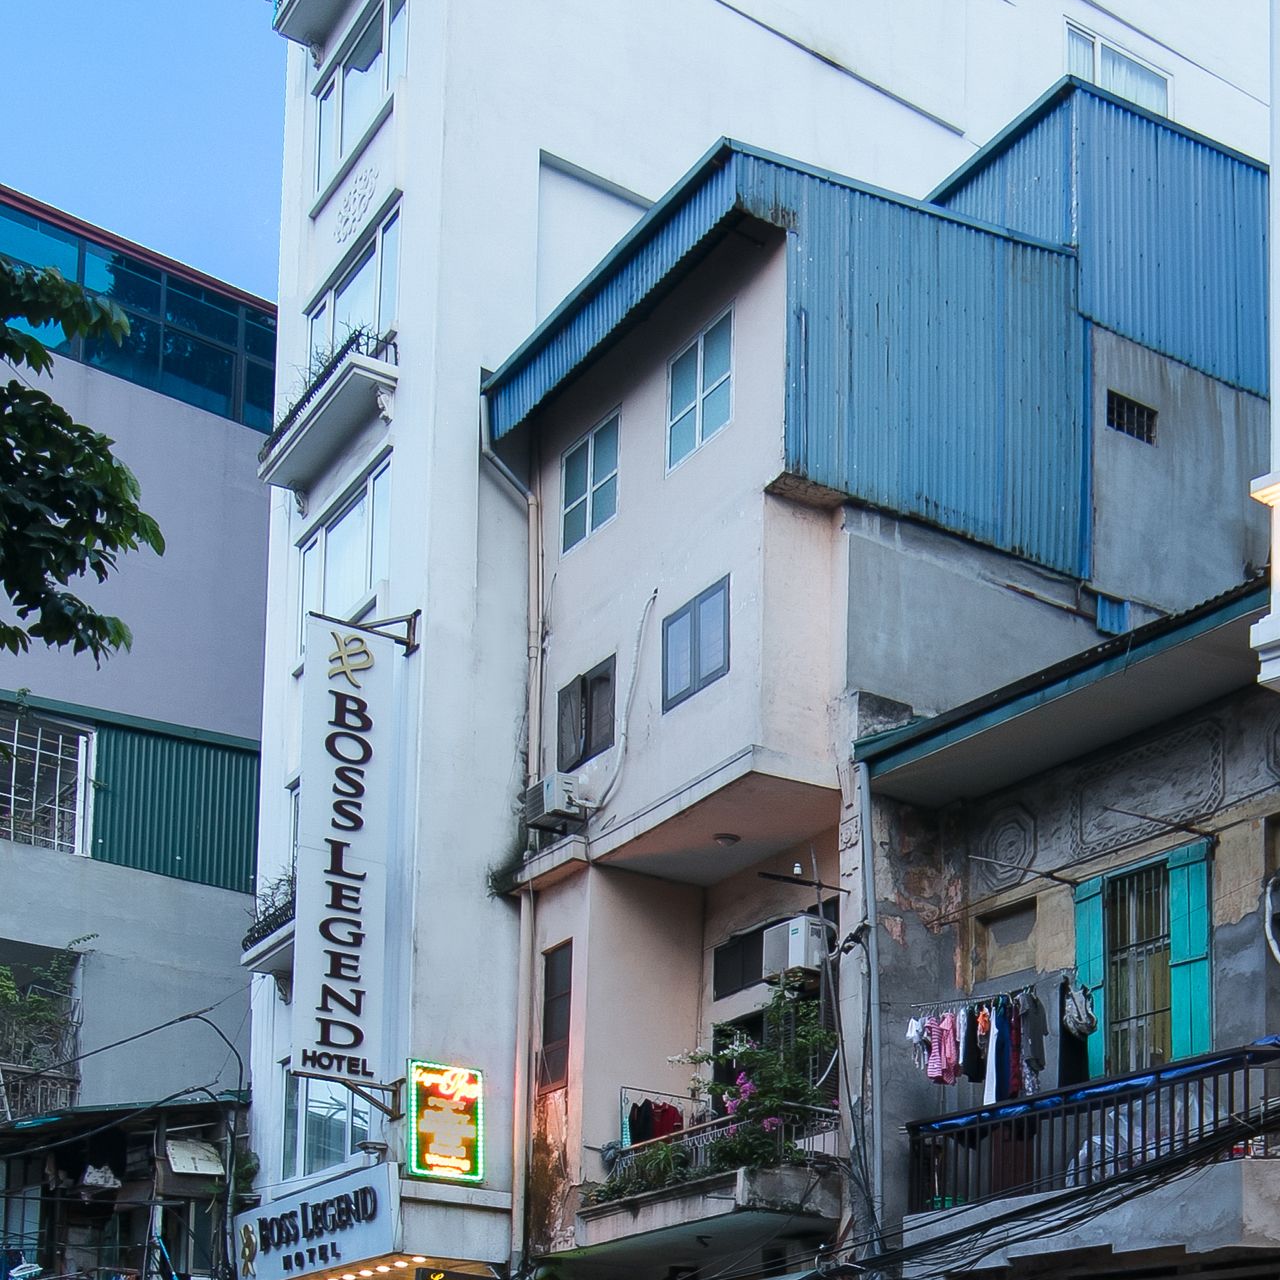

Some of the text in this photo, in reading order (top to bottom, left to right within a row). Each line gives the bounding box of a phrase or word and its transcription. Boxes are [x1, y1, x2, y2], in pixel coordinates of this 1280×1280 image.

[315, 689, 373, 1049] BOSS LEGEND
[302, 1049, 374, 1078] HOTEL
[257, 1186, 378, 1255] BOSS LEGEND
[282, 1242, 341, 1271] HOTEL
